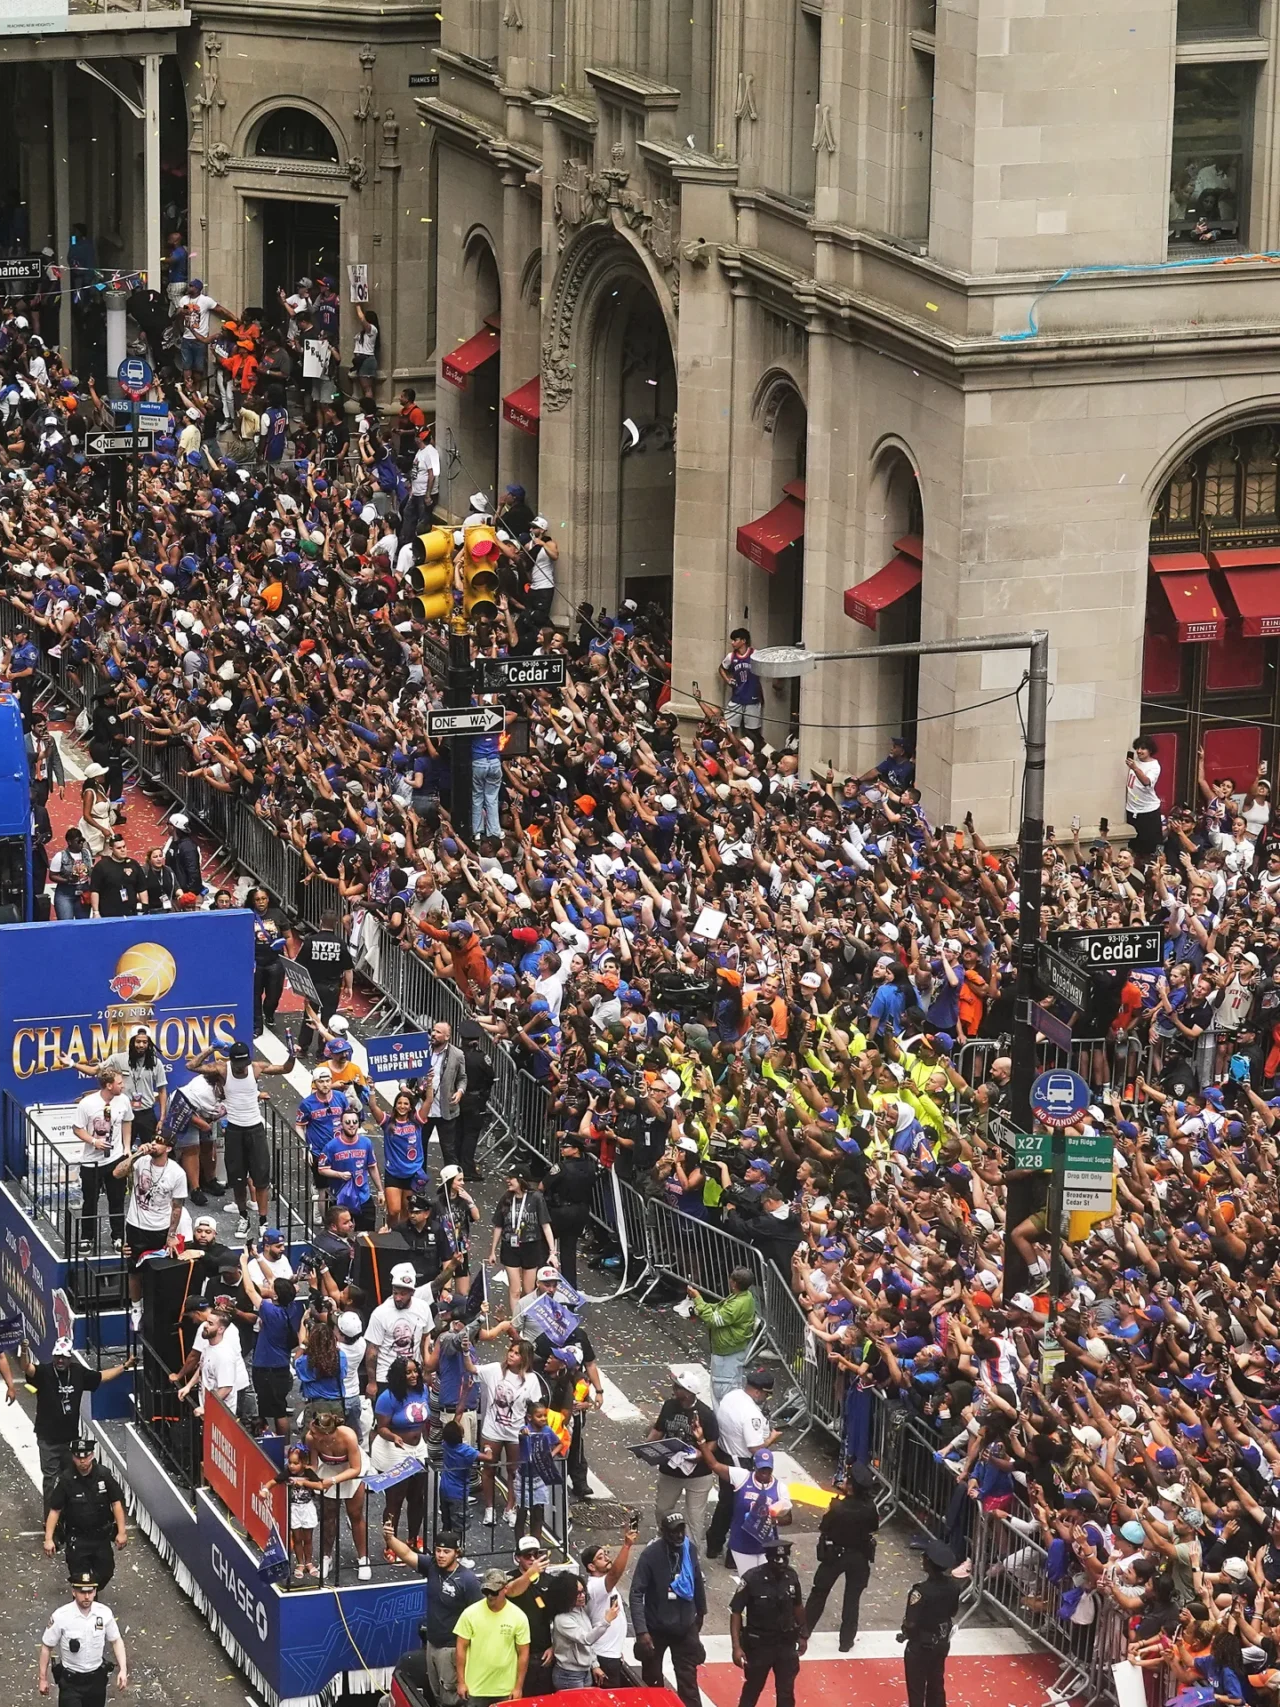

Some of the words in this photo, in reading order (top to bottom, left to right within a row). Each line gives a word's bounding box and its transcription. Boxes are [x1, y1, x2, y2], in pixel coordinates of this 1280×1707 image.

[111, 402, 128, 411] M55
[96, 439, 115, 448] ONE
[124, 438, 144, 447] WY
[1188, 624, 1217, 632] TRINITY
[509, 667, 549, 682] Cedar
[552, 665, 561, 674] ST
[434, 718, 457, 728] ONE
[470, 715, 494, 726] WAY
[1108, 934, 1129, 943] 93-105
[311, 940, 341, 952] NYPD
[1090, 941, 1142, 961] Cedar
[1146, 938, 1157, 949] ST
[311, 951, 340, 961] DCPI
[1052, 968, 1083, 1006] Broadway
[1239, 990, 1250, 1002] YORK
[1231, 998, 1242, 1010] 11
[97, 1009, 124, 1020] 2026
[130, 1007, 155, 1018] NBA
[369, 1054, 389, 1065] THIS
[390, 1053, 398, 1062] IS
[399, 1050, 429, 1061] REALLY
[377, 1059, 423, 1072] HAPPENING
[310, 1110, 326, 1119] NEW
[1035, 1108, 1046, 1120] NO
[1046, 1110, 1084, 1127] STANDING
[992, 1121, 1008, 1141] ONE
[1017, 1137, 1043, 1150] x27
[1068, 1138, 1079, 1146] Bay
[1080, 1138, 1097, 1146] Ridge
[334, 1151, 350, 1160] NEW
[350, 1149, 367, 1158] YORK
[1017, 1154, 1043, 1168] x28
[1066, 1172, 1080, 1180] Drop
[1090, 1173, 1102, 1181] Only
[1066, 1191, 1094, 1201] Broadway
[1066, 1198, 1082, 1206] Cedar
[210, 1422, 236, 1468] MITCHELL
[210, 1442, 237, 1489] ROBINSON
[211, 1543, 254, 1624] CHASE
[378, 1591, 424, 1622] NEW
